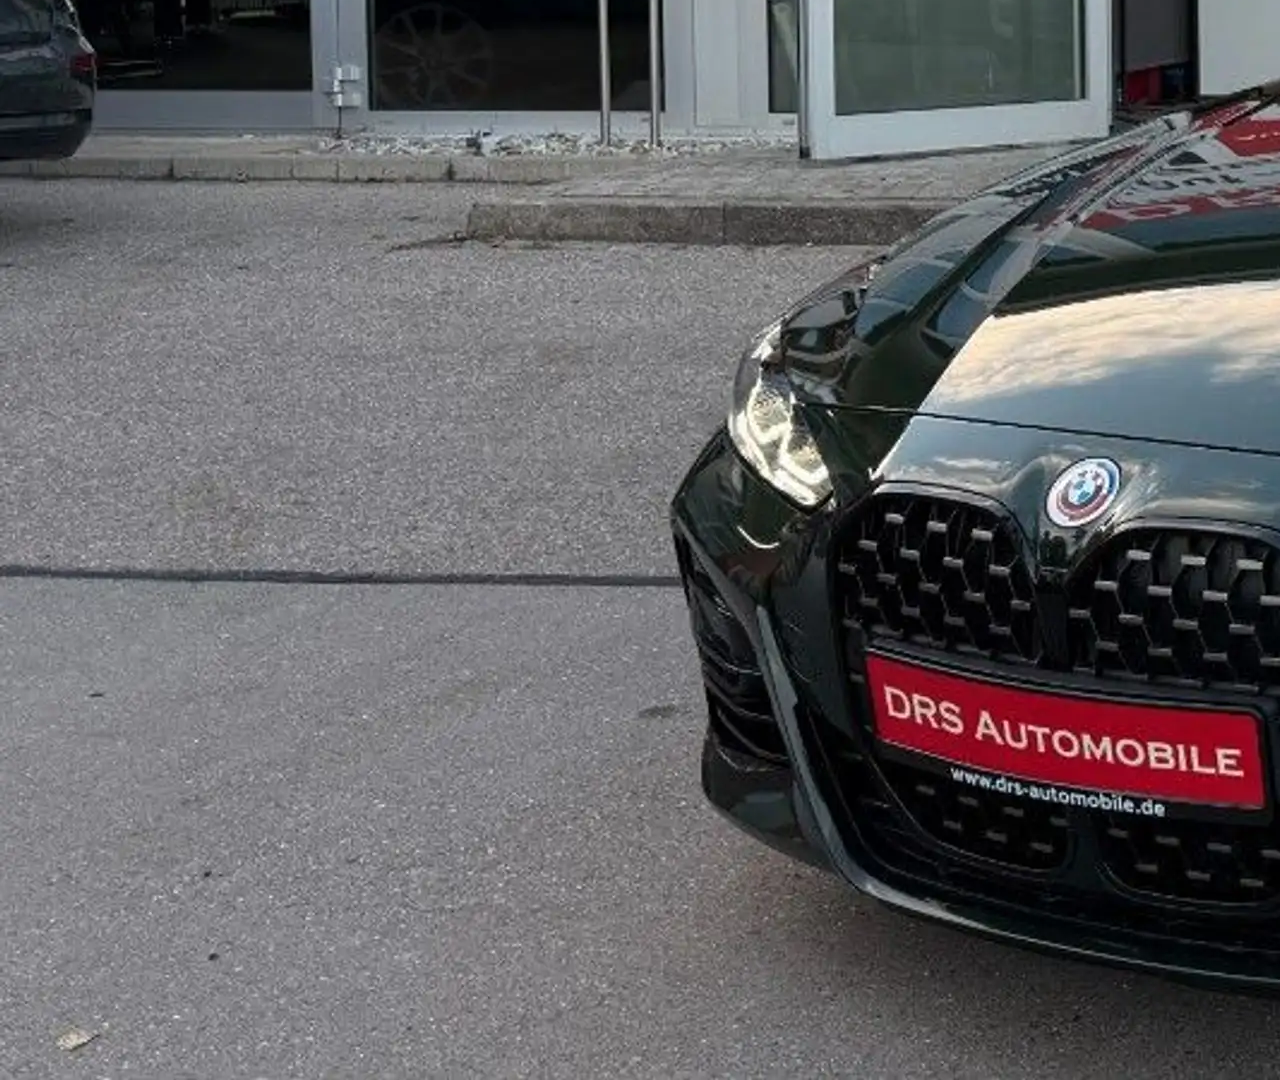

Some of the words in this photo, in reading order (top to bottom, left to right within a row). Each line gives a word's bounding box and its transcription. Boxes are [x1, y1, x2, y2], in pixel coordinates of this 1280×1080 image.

[883, 685, 964, 735] DRS
[975, 711, 1244, 778] AUTOMOBILE
[950, 766, 1166, 818] www.drs-automobile.de
